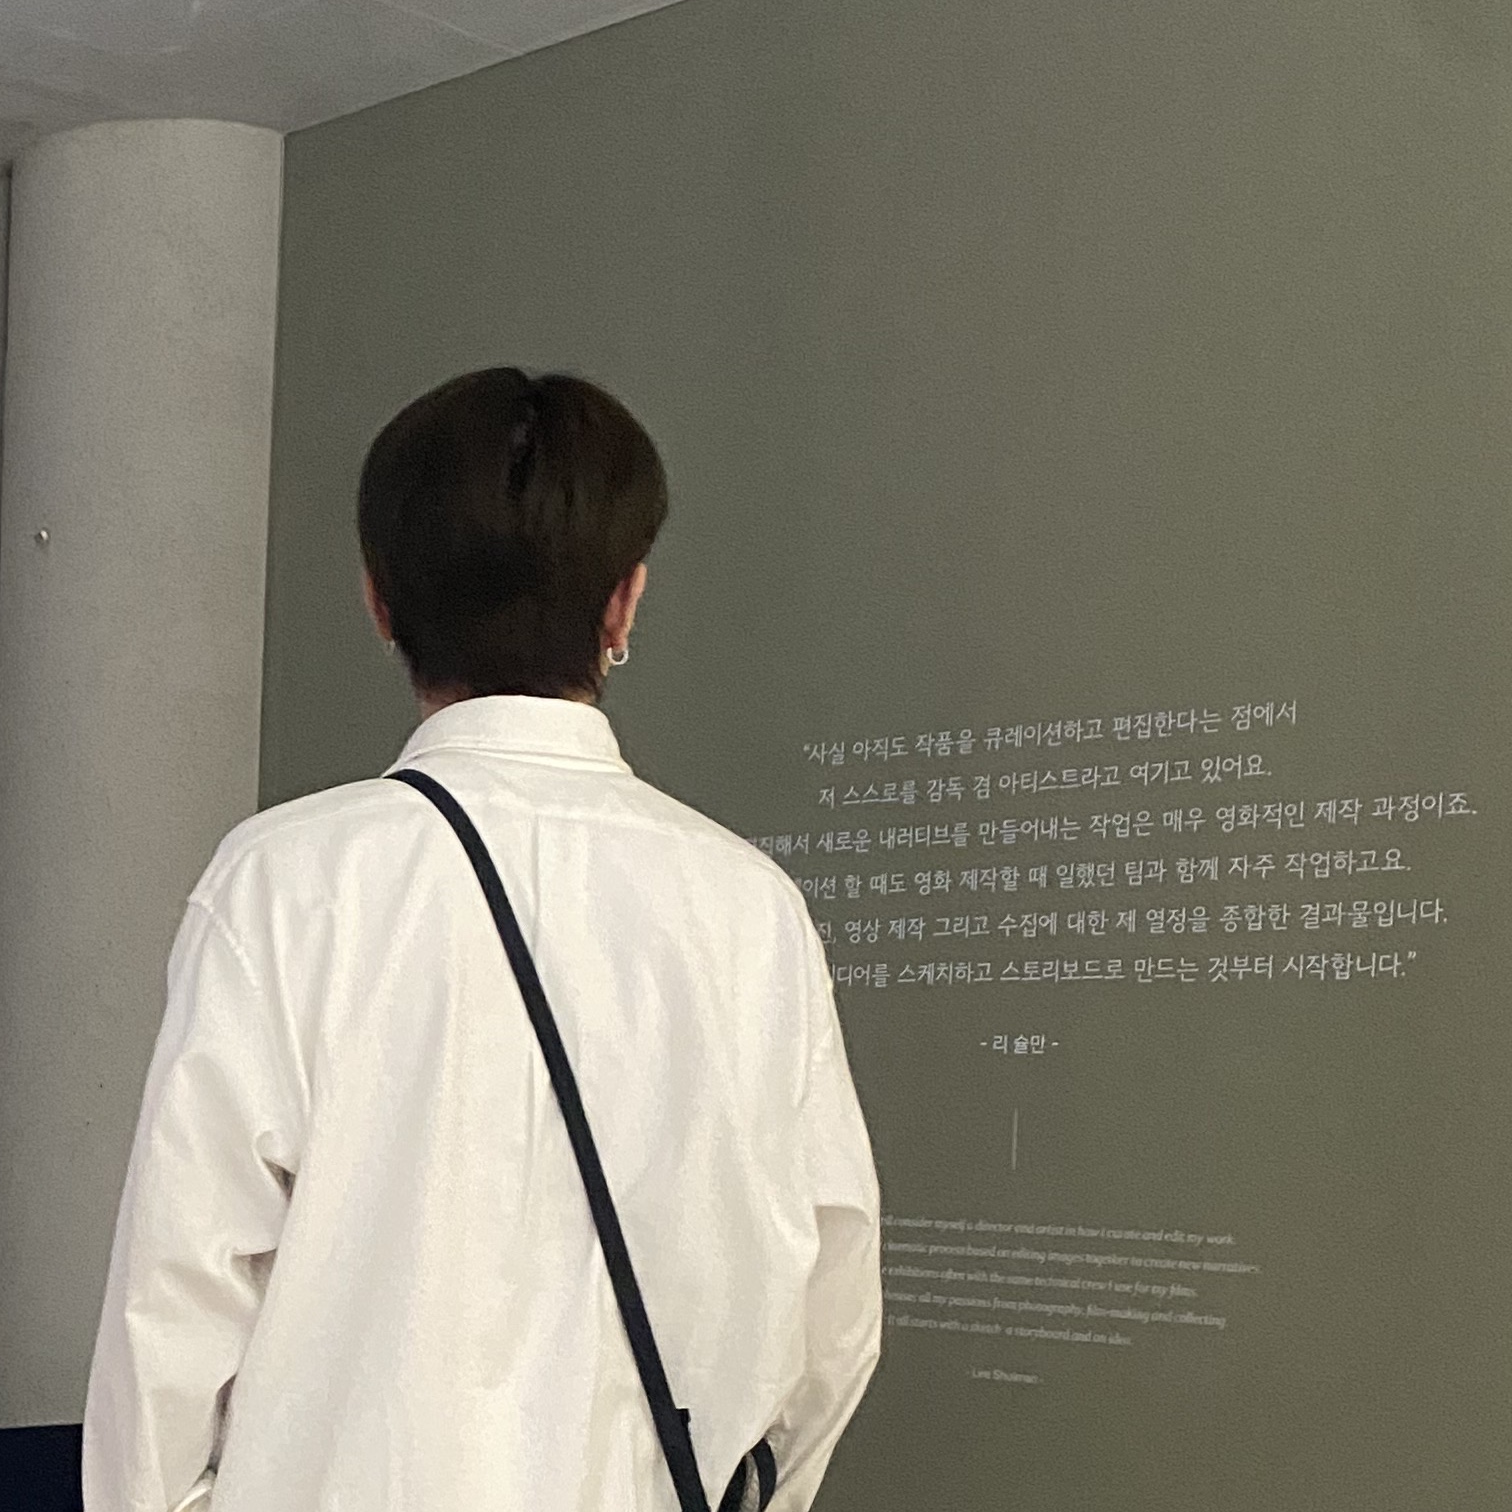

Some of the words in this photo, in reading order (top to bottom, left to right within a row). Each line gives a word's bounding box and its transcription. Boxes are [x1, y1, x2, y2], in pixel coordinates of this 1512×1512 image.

[852, 736, 909, 762] 아직도
[914, 728, 977, 758] 작품을
[983, 718, 1104, 751] 큐레이션하고
[1112, 708, 1223, 741] 편집한다는
[1230, 699, 1297, 731] 점에서
[818, 786, 835, 810] 저
[842, 779, 918, 805] 스스로를
[926, 776, 966, 803] 감독
[972, 773, 991, 800] 겸
[998, 765, 1122, 796] 아티스트라고
[1129, 759, 1193, 787] 여기고
[1200, 753, 1273, 784] 있어요.
[815, 828, 872, 854] 새로운
[879, 821, 971, 850] 내러티브를
[978, 815, 1082, 846] 만들어내는
[1088, 810, 1155, 839] 작업은
[1162, 807, 1207, 833] 매우
[1215, 800, 1305, 833] 영화적인
[1313, 797, 1364, 826] 제작
[1371, 791, 1478, 823] 과정이죠.
[843, 874, 863, 899] 할
[869, 871, 907, 896] 때도
[913, 869, 953, 896] 영화
[958, 865, 1021, 893] 제작할
[1028, 864, 1048, 889] 때
[1055, 860, 1115, 889] 일했던
[1124, 858, 1168, 886] 팀과
[1175, 855, 1219, 884] 함께
[1227, 853, 1276, 880] 자주
[1284, 848, 1412, 881] 작업하고요.
[844, 917, 882, 944] 영상
[887, 916, 927, 942] 제작
[932, 915, 991, 939] 그리고
[997, 911, 1058, 938] 수집에
[1067, 909, 1110, 936] 대한
[1115, 908, 1137, 933] 제
[1145, 905, 1211, 934] 열정을
[1218, 902, 1292, 933] 종합한
[1299, 897, 1448, 930] 결과물입니다.
[896, 961, 994, 986] 스케치하고
[999, 958, 1126, 983] 스토리보드로
[1134, 956, 1200, 983] 만드는
[1207, 953, 1274, 983] 것부터
[966, 1242, 997, 1257] based
